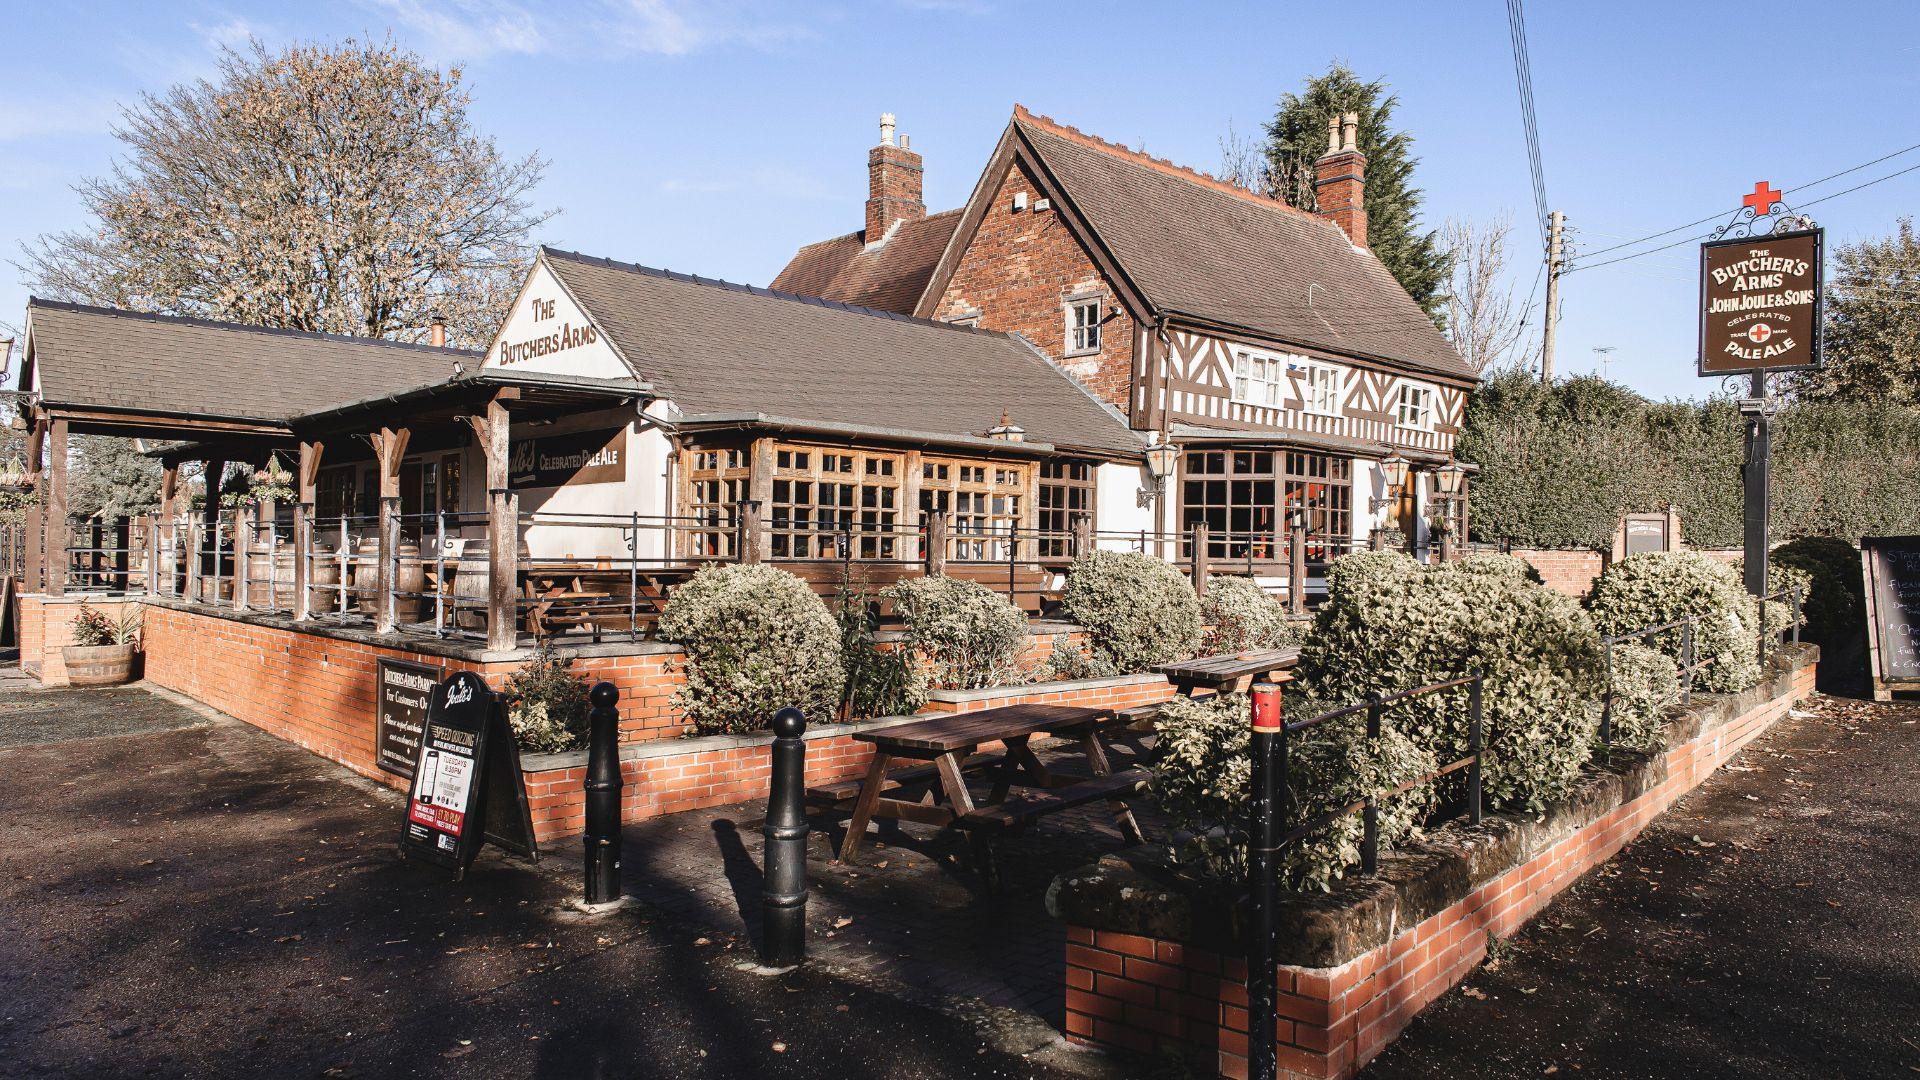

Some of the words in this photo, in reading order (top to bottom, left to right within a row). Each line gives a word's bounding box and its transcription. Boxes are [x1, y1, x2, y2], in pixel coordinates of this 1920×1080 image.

[1750, 250, 1770, 258] THE
[1711, 258, 1809, 285] BUTCHER'S
[1733, 273, 1783, 292] ARMS
[532, 298, 556, 323] THE
[1709, 297, 1740, 314] JOHN
[1739, 293, 1775, 311] JOULE
[1785, 289, 1815, 305] SONS
[1727, 312, 1791, 327] CELEBRATED
[561, 322, 597, 350] ARMS
[1724, 341, 1762, 360] PALE
[1763, 337, 1797, 358] ALE
[539, 453, 582, 471] CELEBRATED
[582, 449, 601, 467] PALE
[600, 447, 618, 466] ALE
[386, 688, 395, 702] For
[395, 691, 419, 708] Customers
